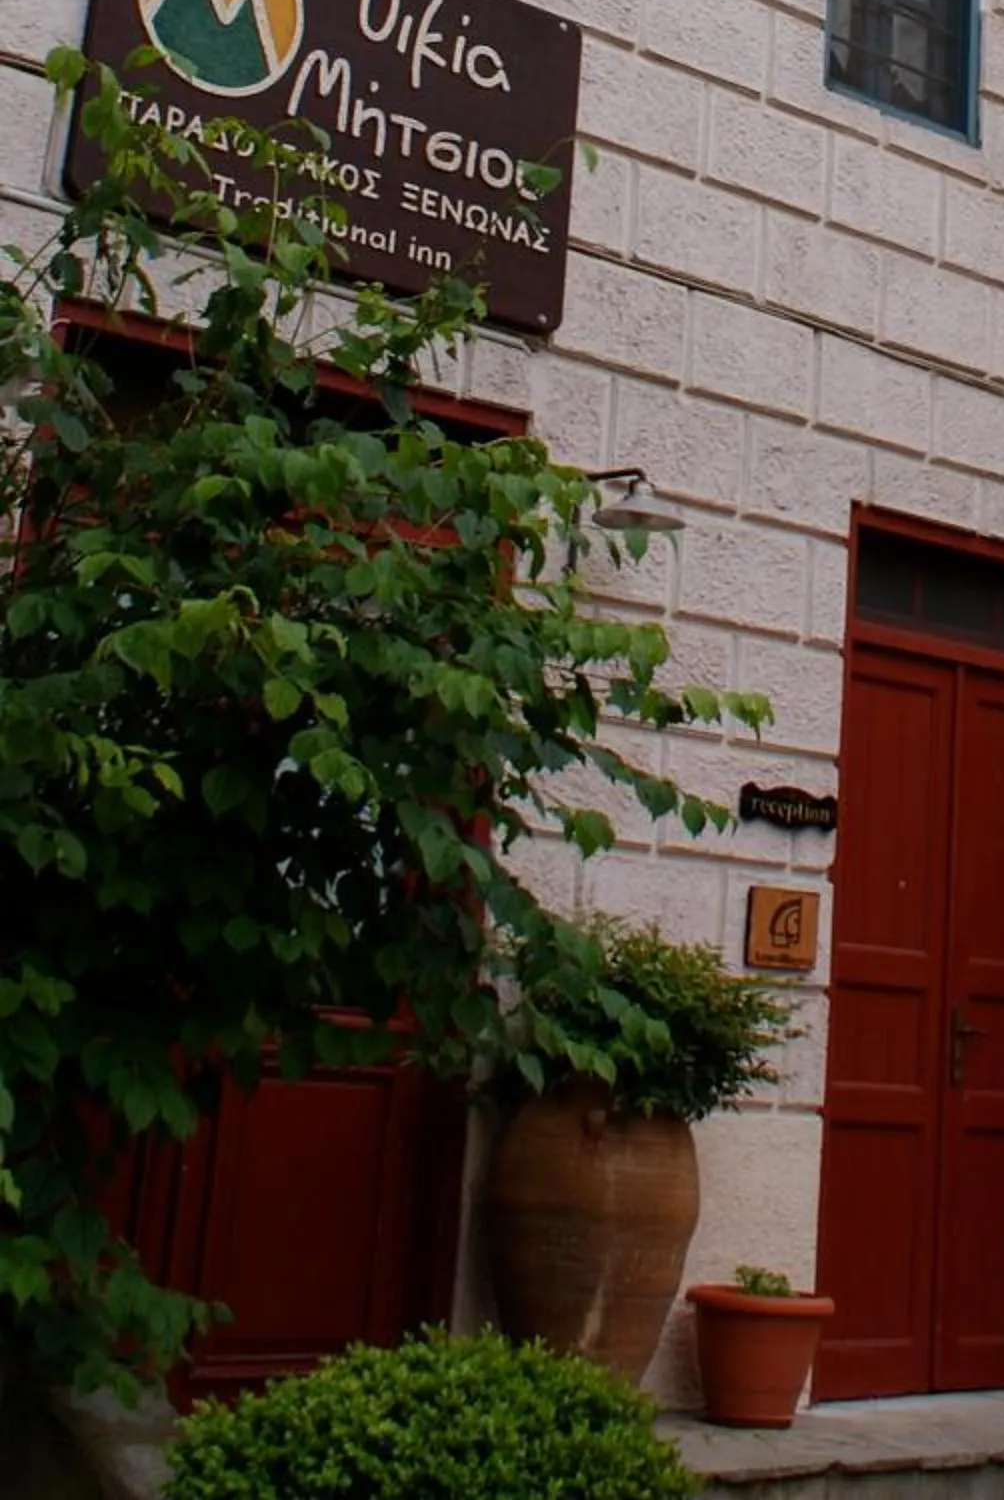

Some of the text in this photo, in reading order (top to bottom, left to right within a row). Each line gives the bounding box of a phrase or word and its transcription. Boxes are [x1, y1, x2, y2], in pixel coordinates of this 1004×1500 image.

[400, 181, 550, 253] ΞΕΝΩΝΑΣ
[408, 235, 452, 272] inn
[751, 797, 830, 824] reception
